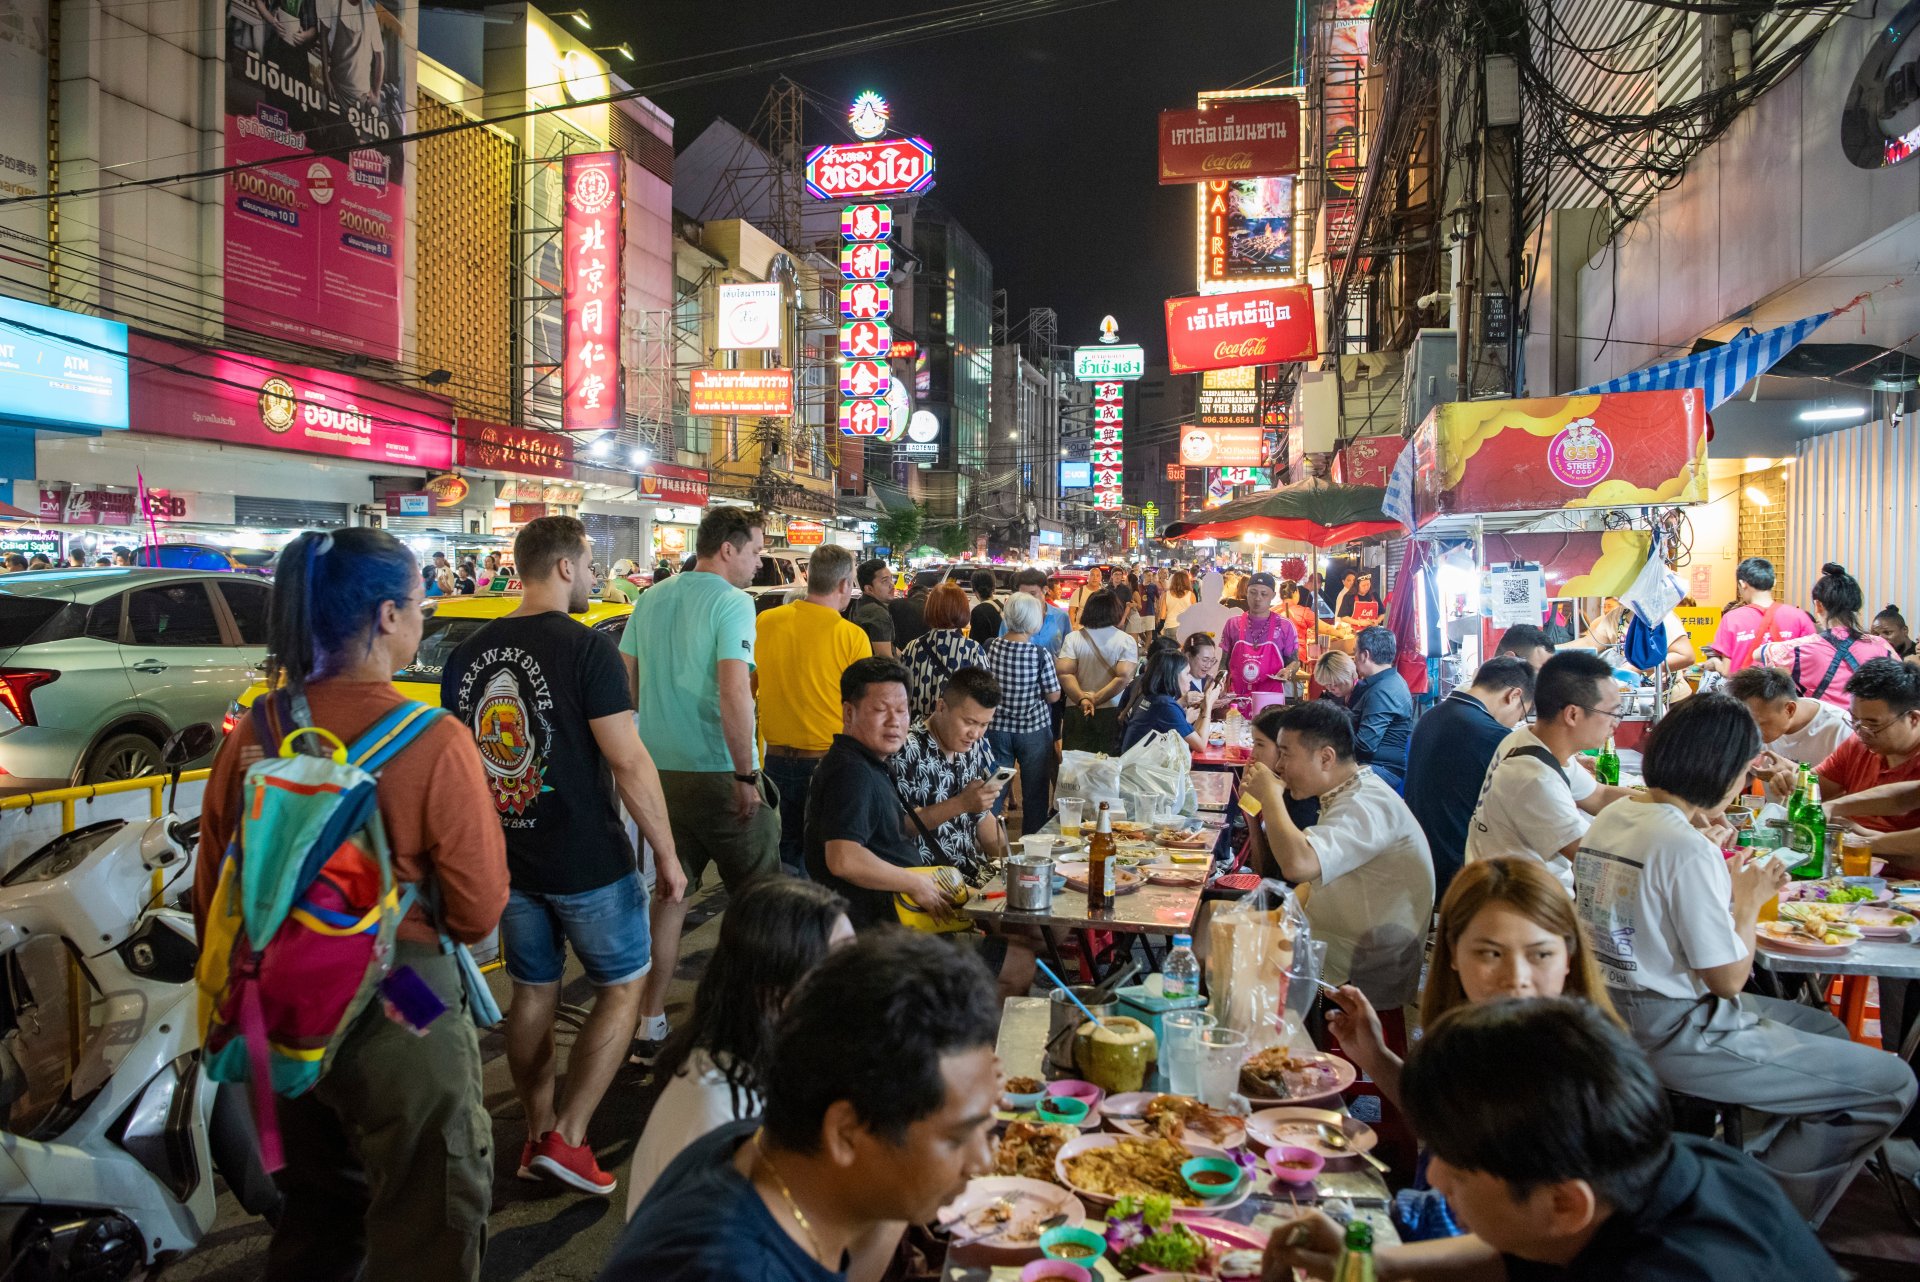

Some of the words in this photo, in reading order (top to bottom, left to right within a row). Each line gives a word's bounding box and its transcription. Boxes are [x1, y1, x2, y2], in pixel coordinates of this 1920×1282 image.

[245, 51, 321, 112] มีเงินทุน
[348, 102, 389, 139] อุ่นใจ
[237, 116, 306, 150] ธุรกิจรายย่อย
[1171, 115, 1287, 145] เกาลัดเทียนซาน
[278, 210, 288, 221] 10
[339, 209, 385, 238] 200,000
[578, 219, 606, 409] 北京同仁堂
[1214, 337, 1268, 360] Coca-Cola
[63, 355, 89, 371] ATM
[304, 404, 372, 434] ออมสิน
[1201, 404, 1211, 414] IN
[1213, 404, 1230, 414] THE
[1231, 404, 1256, 414] BREW
[1202, 416, 1255, 424] 096.324.6541
[1563, 446, 1597, 460] GSB
[1566, 462, 1596, 470] STREET
[458, 647, 525, 712] PARKWAY
[521, 654, 555, 711] DRIVE
